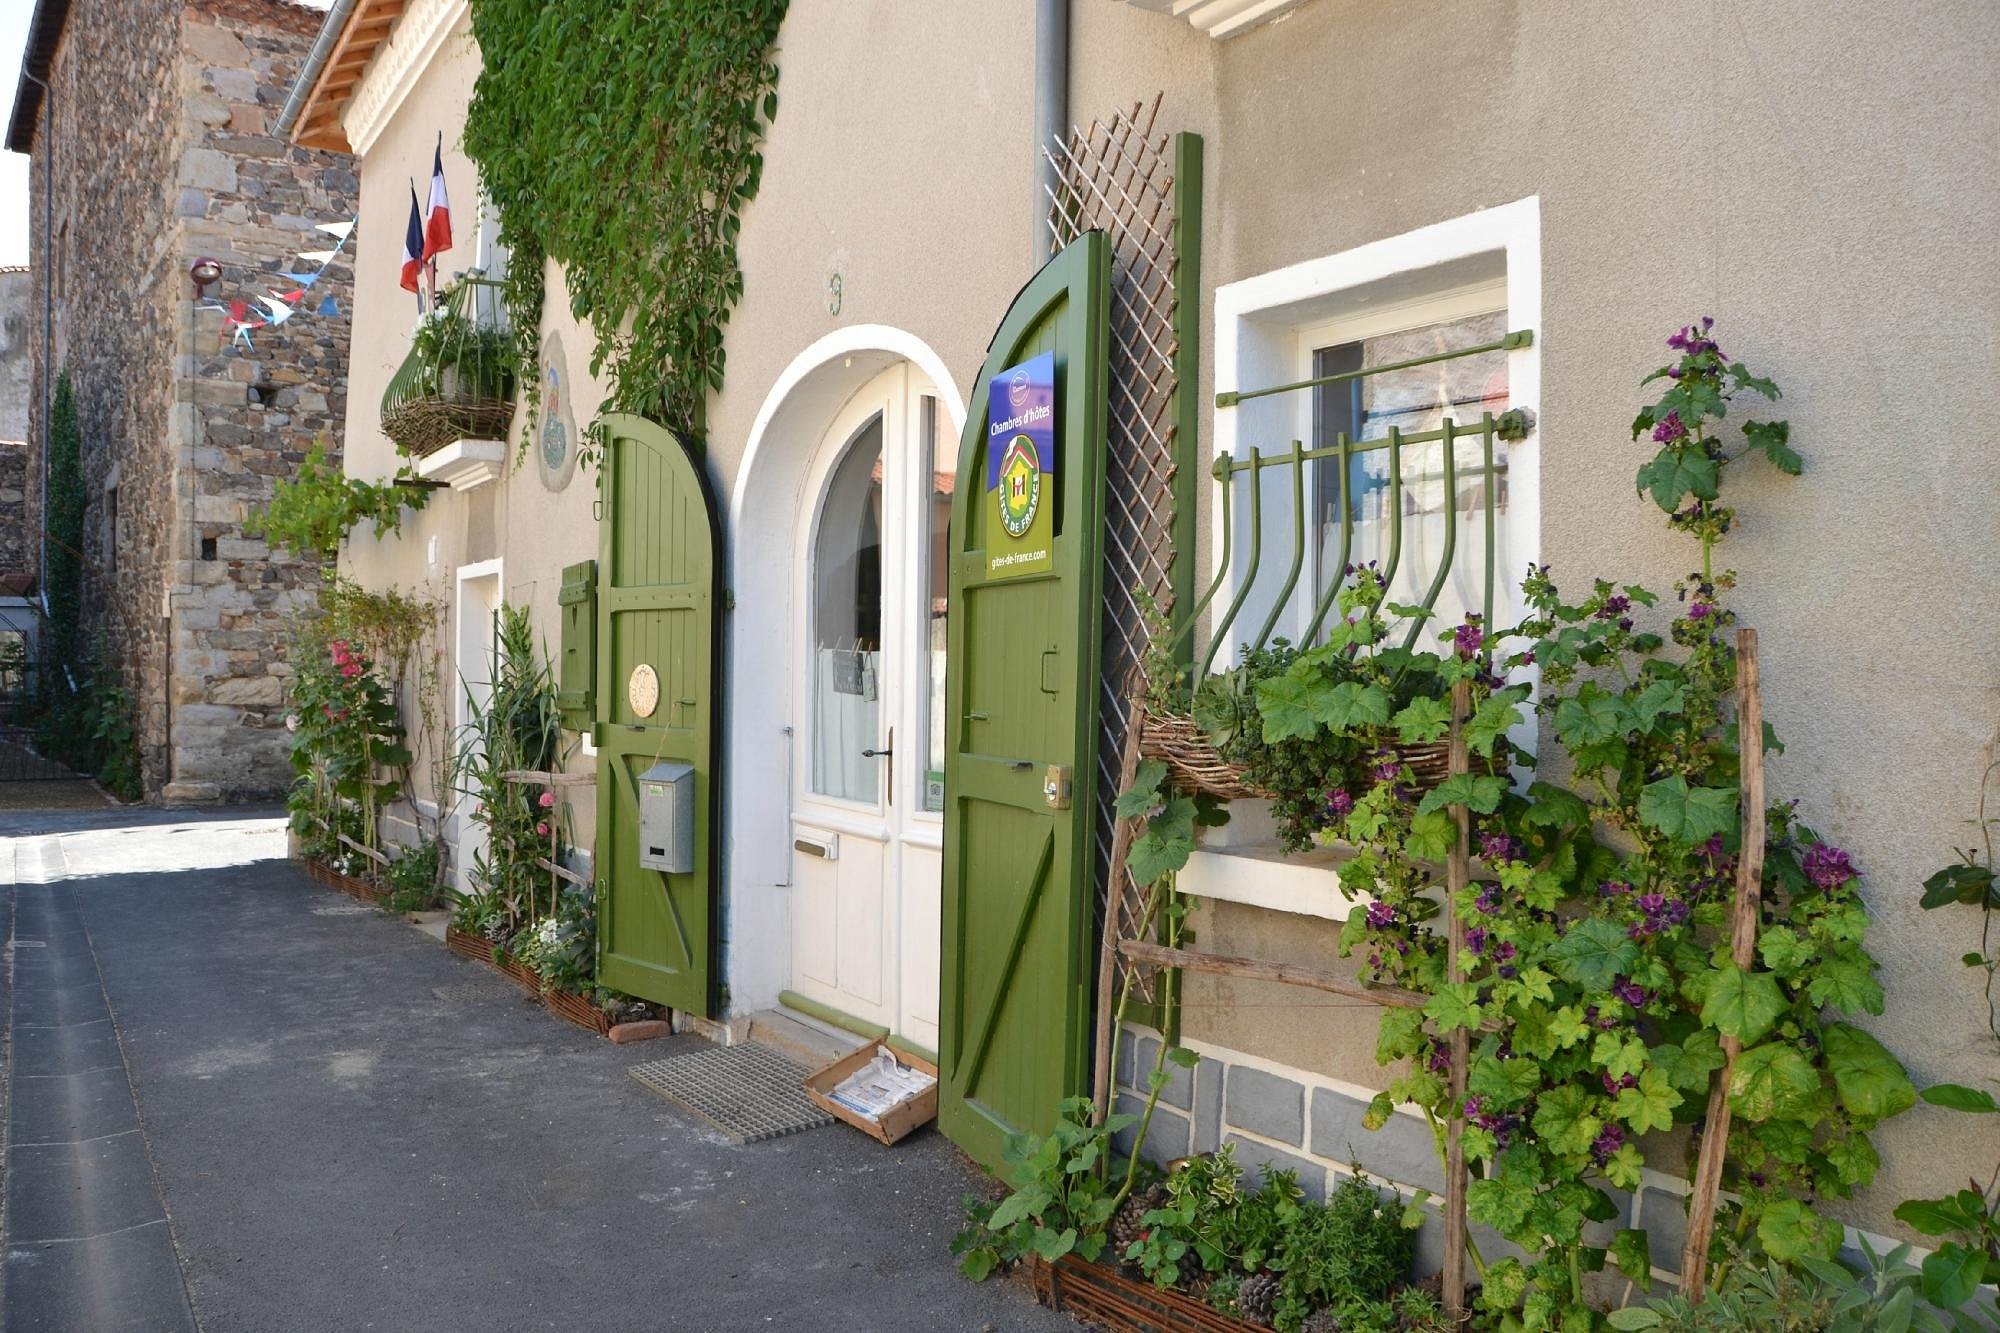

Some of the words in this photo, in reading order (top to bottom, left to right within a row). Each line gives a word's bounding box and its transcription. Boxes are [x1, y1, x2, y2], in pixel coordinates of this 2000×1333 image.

[830, 272, 842, 317] 9
[990, 414, 1023, 436] Chambres
[1023, 405, 1050, 424] d'hôtes
[1010, 521, 1020, 533] DE
[1021, 473, 1039, 530] FRANCE
[991, 550, 1047, 570] gites-de-france.com
